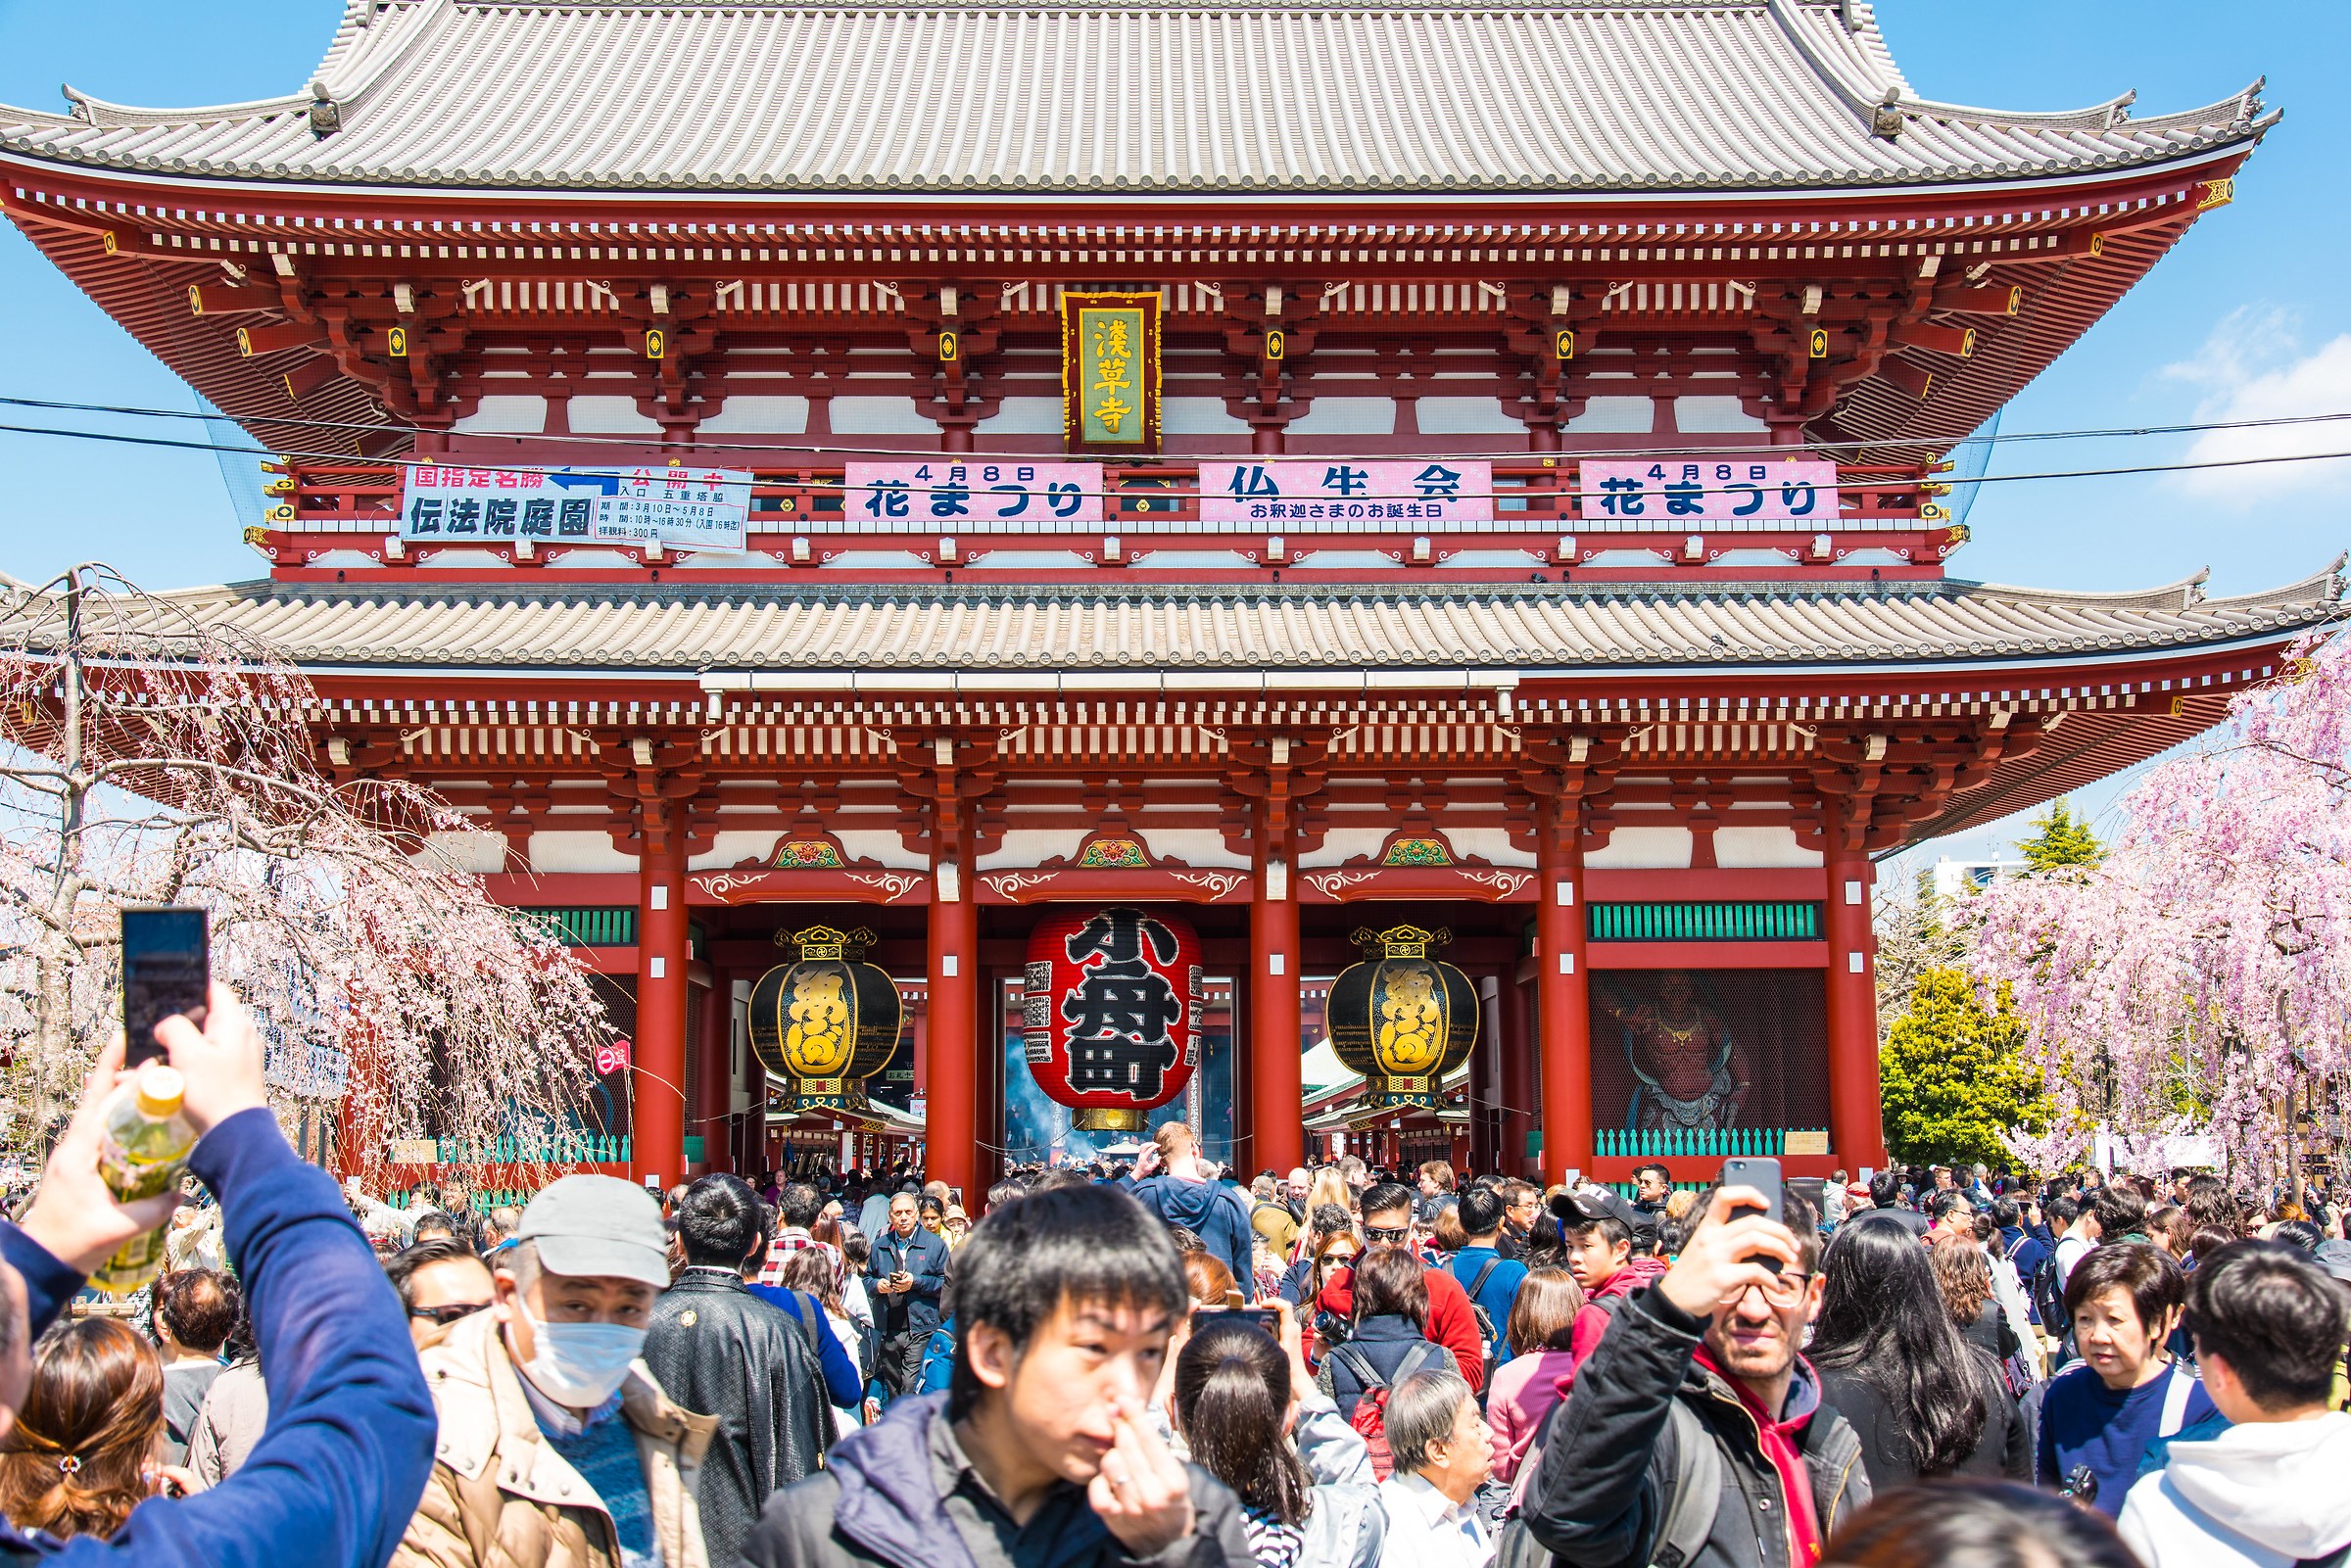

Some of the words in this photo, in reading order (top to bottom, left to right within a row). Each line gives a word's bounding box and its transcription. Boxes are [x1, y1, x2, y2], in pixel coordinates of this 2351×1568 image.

[415, 466, 545, 488] 国指定名勝
[1227, 464, 1462, 503] 仏生会
[1600, 477, 1816, 515] 花まつり
[410, 497, 592, 536] 伝法院庭園
[865, 479, 1081, 518] 花まつり
[1250, 503, 1443, 518] お釈迦さまのお誕生日
